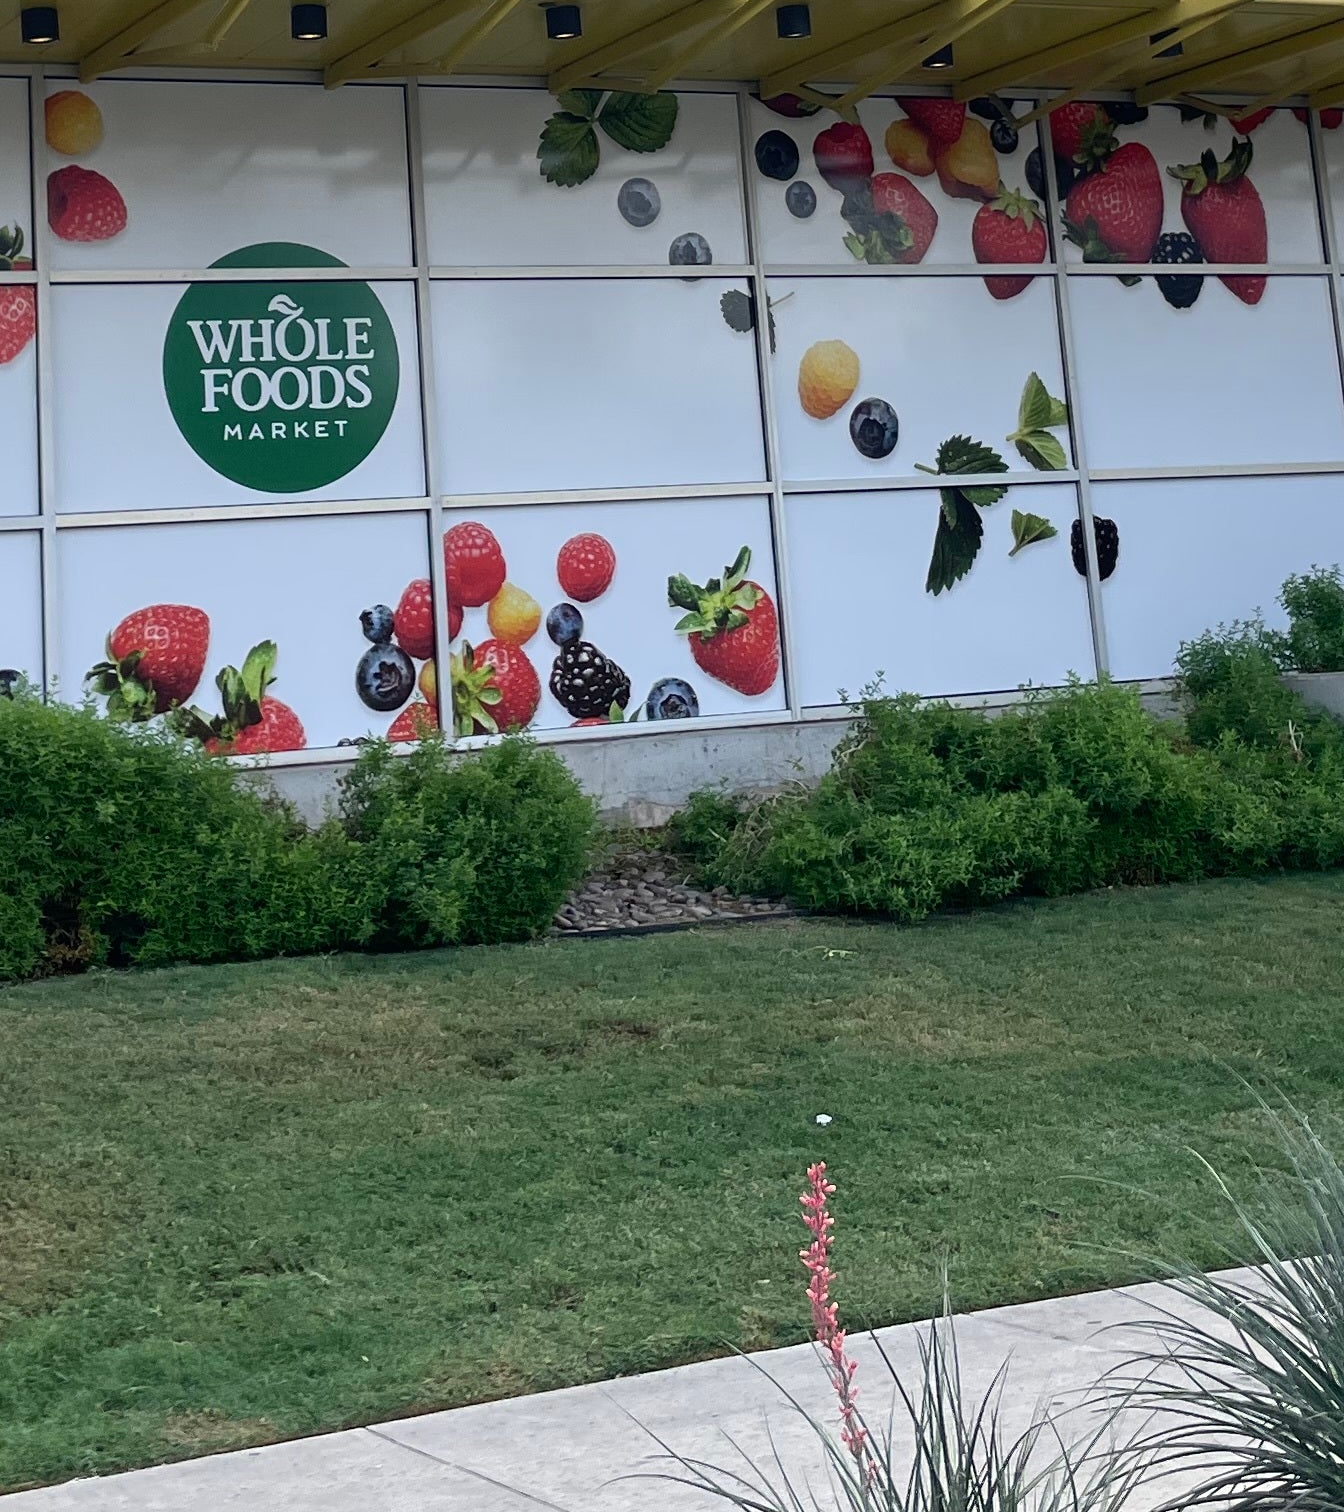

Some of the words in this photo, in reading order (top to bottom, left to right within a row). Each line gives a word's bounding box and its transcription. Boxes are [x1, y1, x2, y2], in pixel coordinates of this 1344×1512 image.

[186, 293, 375, 364] WHOLE
[200, 364, 373, 413] FOODS
[223, 419, 349, 441] MARKET
